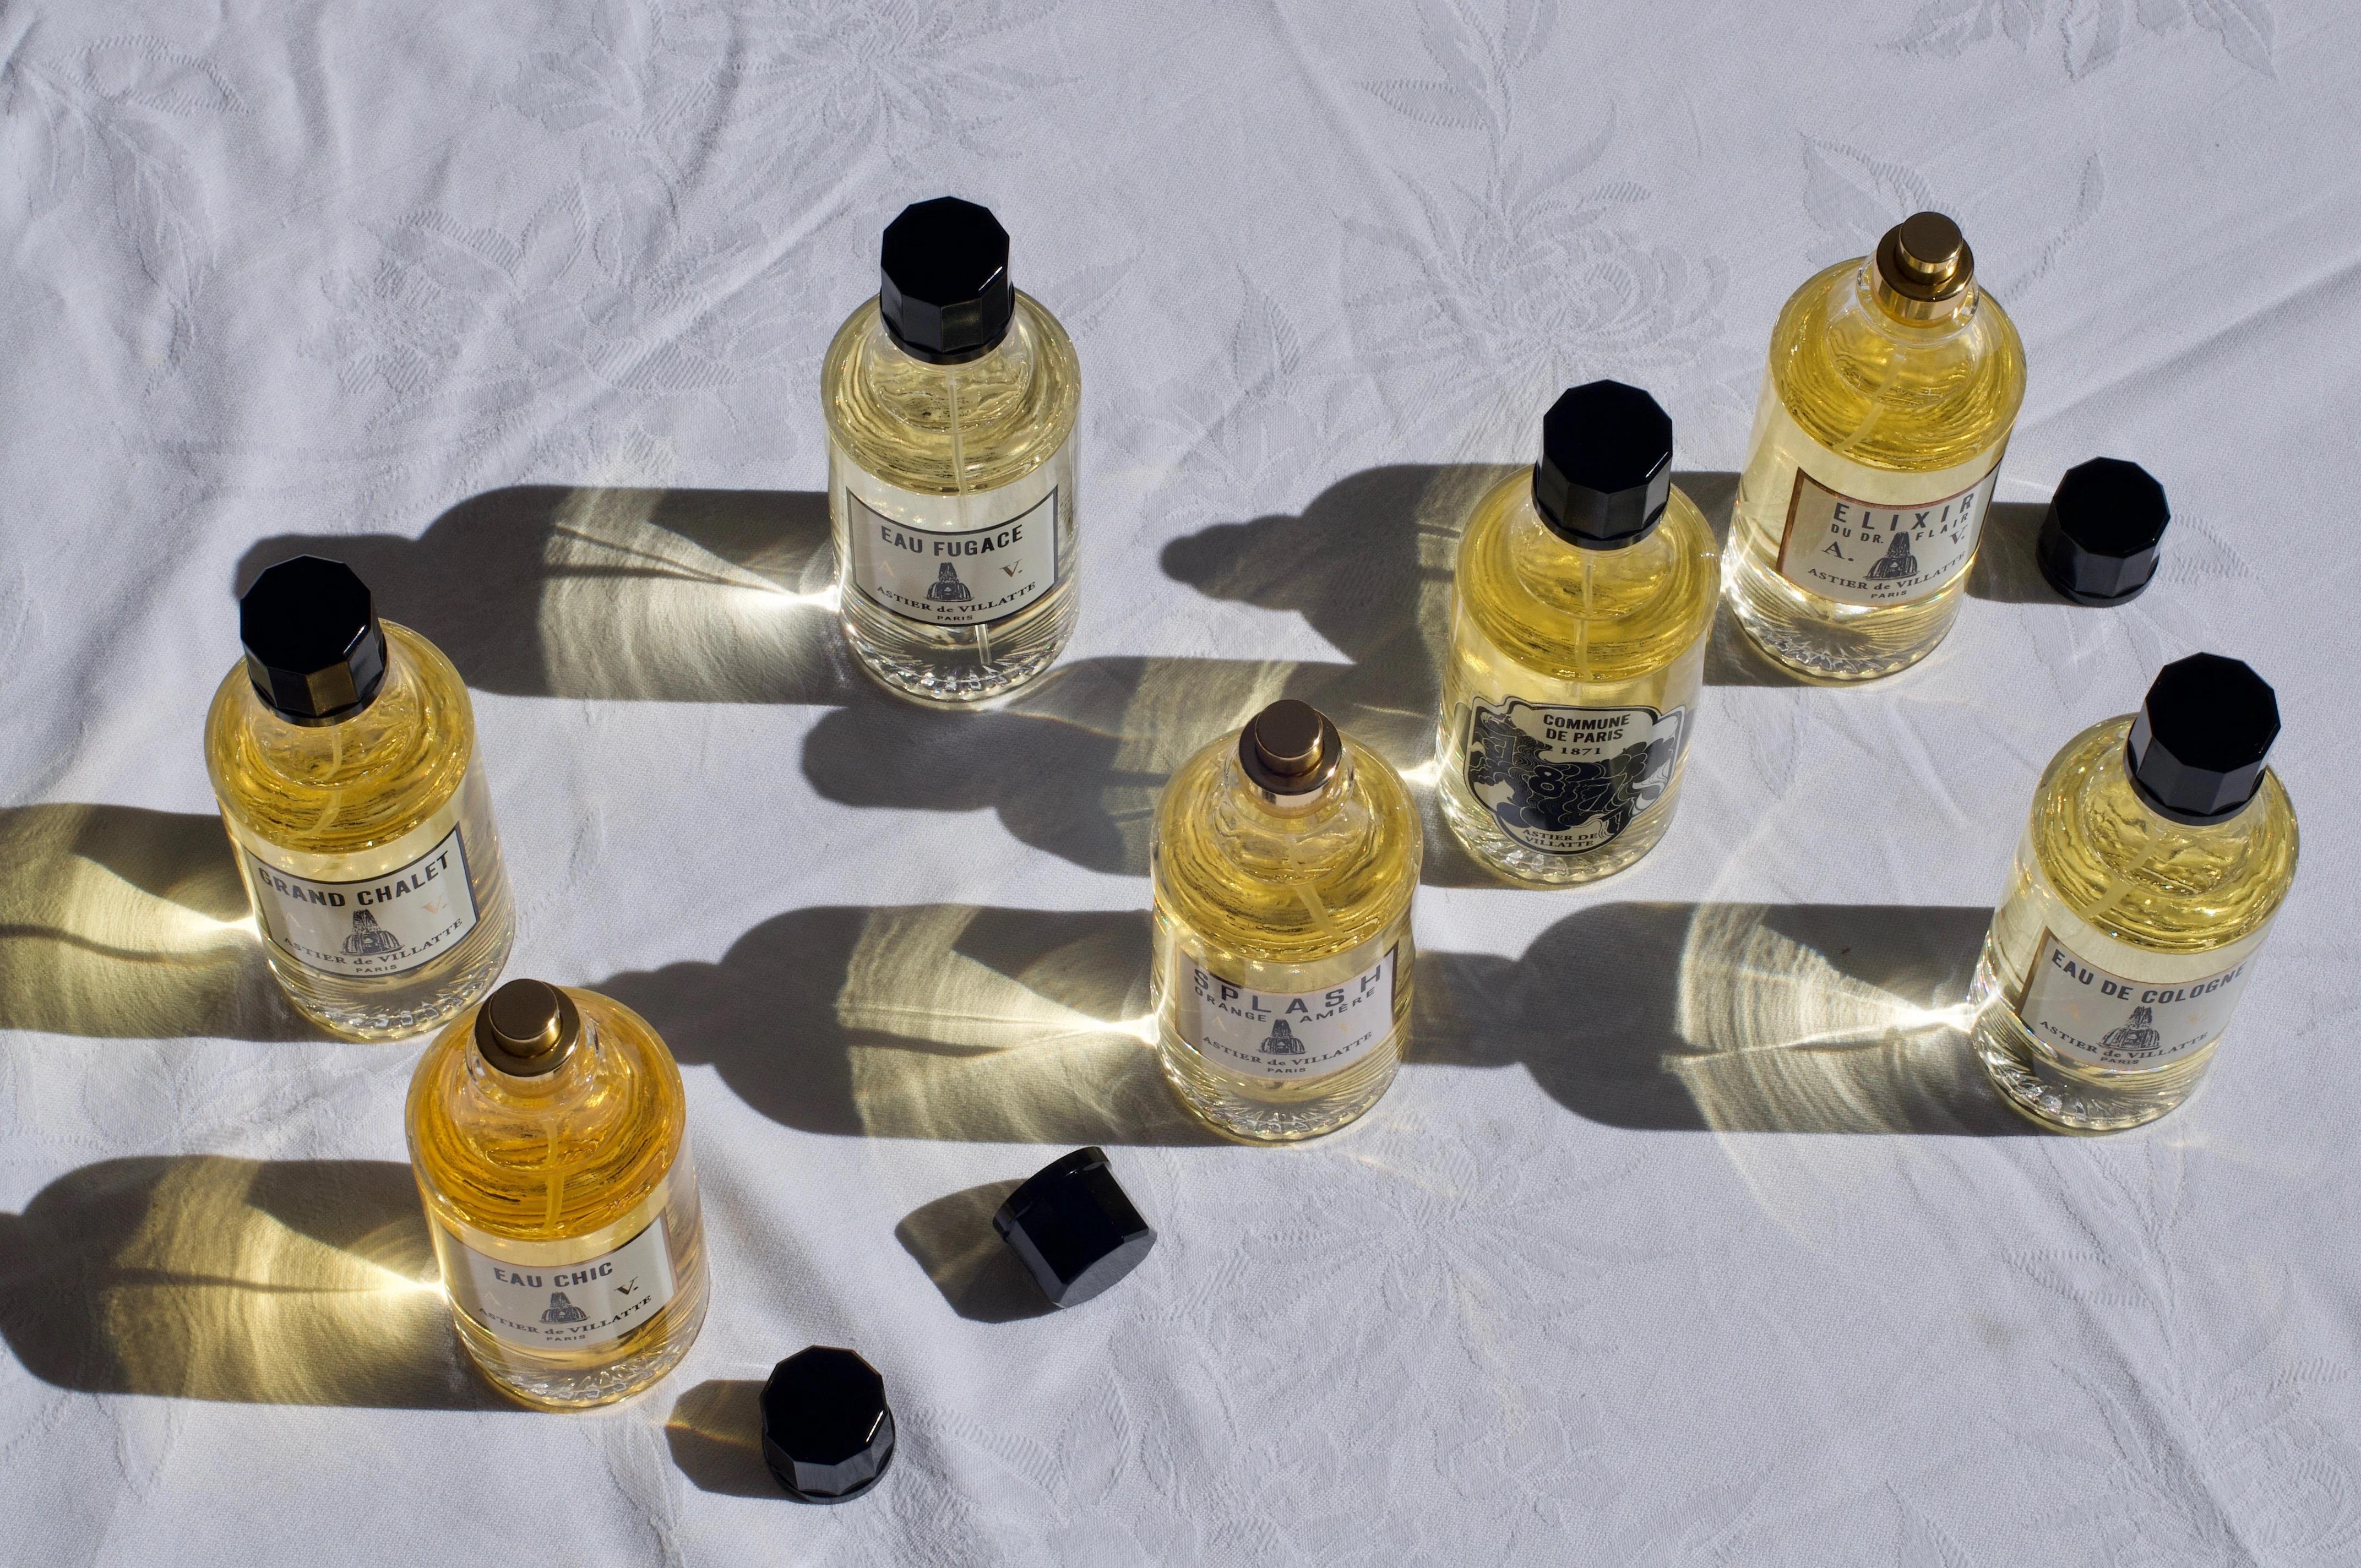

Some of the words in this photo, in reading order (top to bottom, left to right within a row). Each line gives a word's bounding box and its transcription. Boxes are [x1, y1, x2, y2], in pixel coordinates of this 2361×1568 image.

[1831, 523, 1851, 538] DU
[1860, 532, 1884, 544] DR.
[1916, 512, 1968, 541] FLAIR
[1833, 493, 1975, 531] ELIXIR
[882, 525, 923, 553] EAU
[934, 525, 1022, 557] FUGACE
[1949, 524, 1968, 545] V.
[1821, 541, 1855, 562] A.
[999, 559, 1022, 578] V.
[1807, 568, 1869, 591] ASTIER
[1873, 582, 1891, 591] de
[1896, 550, 1966, 589] VILLATTE
[876, 585, 932, 611] ASTIER
[958, 581, 1036, 613] VILLATTE
[1870, 590, 1908, 599] PARIS
[1542, 714, 1631, 731] COMMUNE
[1546, 728, 1568, 741] DE
[1573, 728, 1623, 743] PARIS
[1560, 747, 1602, 756] 1871
[1521, 829, 1573, 841] ASTIER
[1578, 832, 1598, 840] DE
[1525, 836, 1595, 848] VILLATTE
[259, 867, 346, 907] GRAND
[357, 850, 449, 906] CHALET
[284, 937, 347, 965] ASTIER
[353, 957, 373, 965] de
[376, 918, 463, 963] VILLATTE
[356, 964, 397, 973] PARIS
[2051, 949, 2094, 986] EAU
[2100, 979, 2134, 1001] DE
[2141, 961, 2248, 1004] COLOGNE
[1194, 964, 1381, 1014] SPLASH
[1195, 986, 1267, 1022] ORANGE
[1299, 986, 1375, 1023] AMÈRE
[1203, 1036, 1262, 1064] ASTIER
[1267, 1058, 1286, 1066] de
[1290, 1031, 1373, 1066] VILLATTE
[2039, 1020, 2098, 1054] ASTIER
[2126, 1031, 2209, 1059] VILLATTE
[493, 1267, 543, 1288] EAU
[554, 1262, 613, 1287] CHIC
[613, 1276, 639, 1295] V.
[478, 1308, 538, 1333] ASTIER
[567, 1295, 652, 1333] VILLATTE
